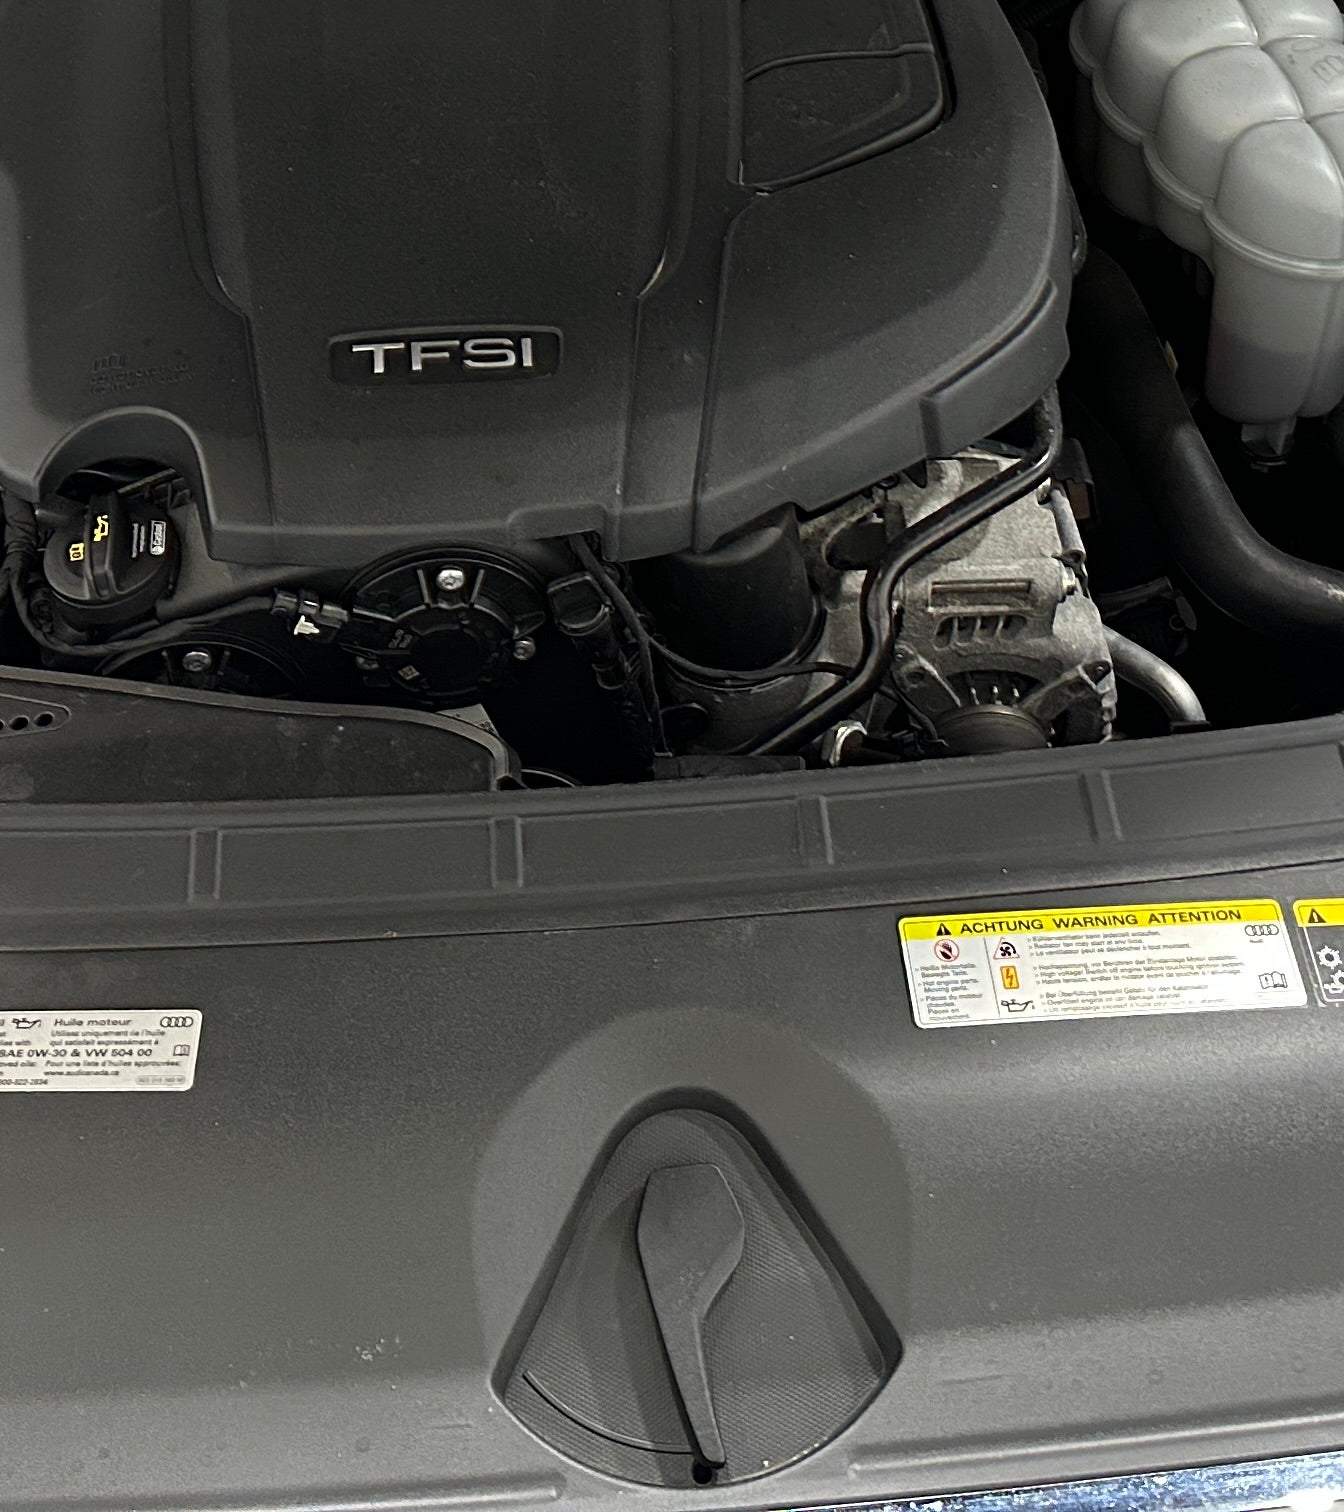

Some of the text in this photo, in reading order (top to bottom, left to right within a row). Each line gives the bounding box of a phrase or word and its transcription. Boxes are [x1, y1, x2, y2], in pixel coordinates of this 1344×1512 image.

[351, 338, 533, 374] TFSI
[961, 910, 1241, 934] ACHTUNG WARNING ATTENTION
[54, 1018, 84, 1026] Huile
[27, 1049, 67, 1058] 0W-30
[71, 1049, 81, 1057] &
[85, 1049, 108, 1057] VW
[111, 1048, 133, 1057] 504
[137, 1048, 153, 1057] 00
